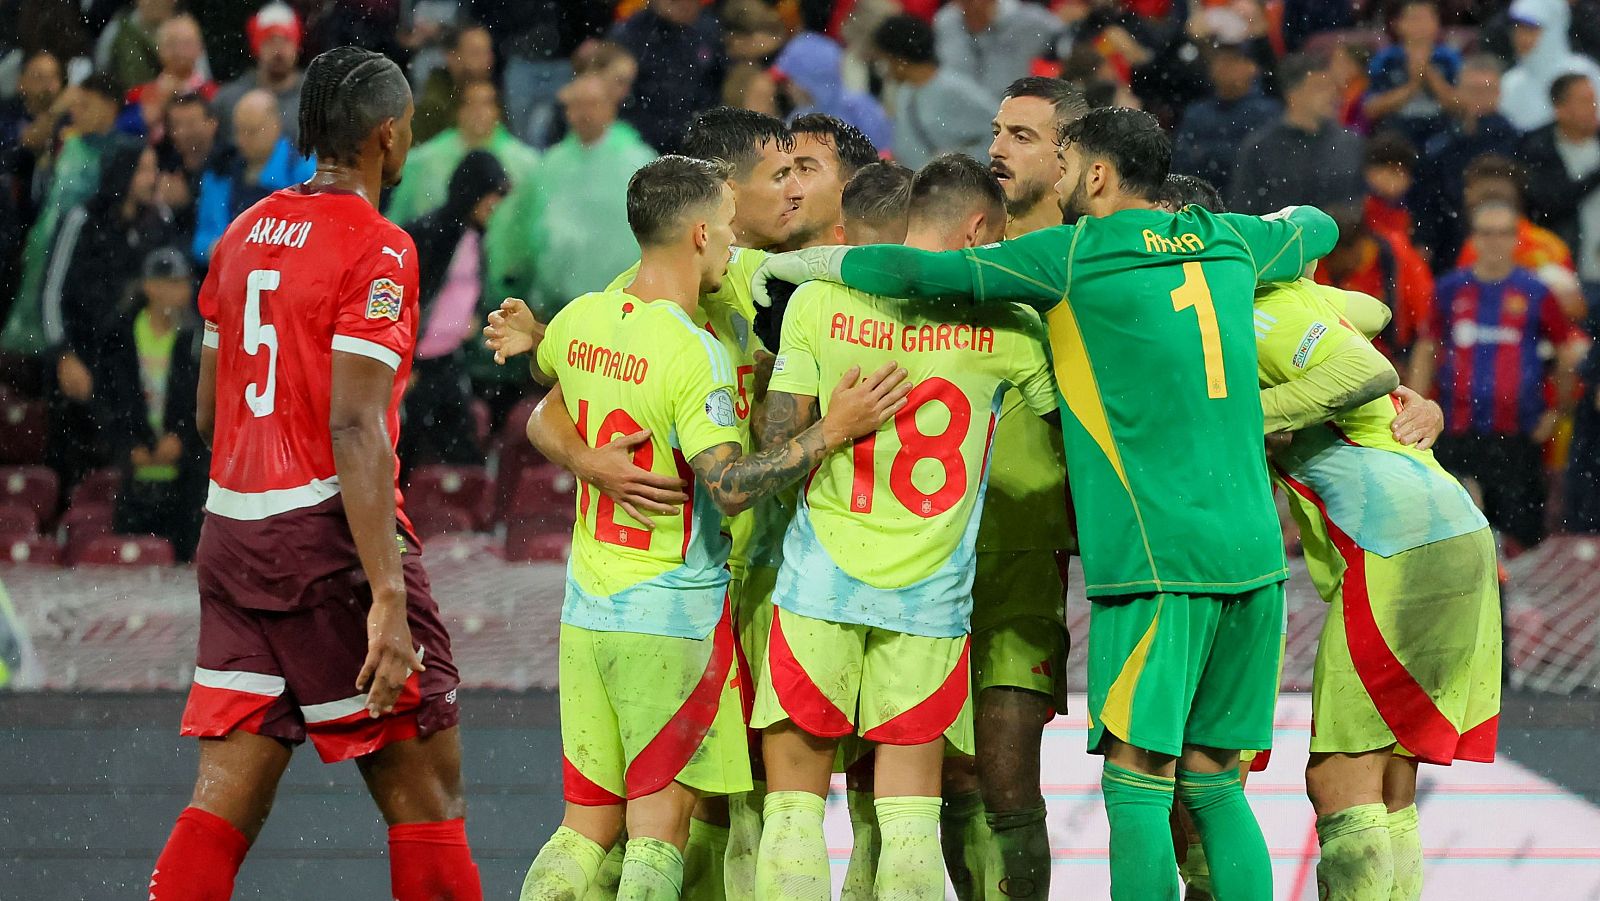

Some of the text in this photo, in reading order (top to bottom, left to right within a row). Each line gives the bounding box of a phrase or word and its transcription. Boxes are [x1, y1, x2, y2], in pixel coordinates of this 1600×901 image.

[245, 217, 312, 248] AKANJI
[243, 269, 281, 418] 5
[567, 339, 649, 385] GRIMALDO
[830, 312, 895, 351] ALEIX
[1170, 261, 1228, 399] 1
[850, 376, 972, 519] 18
